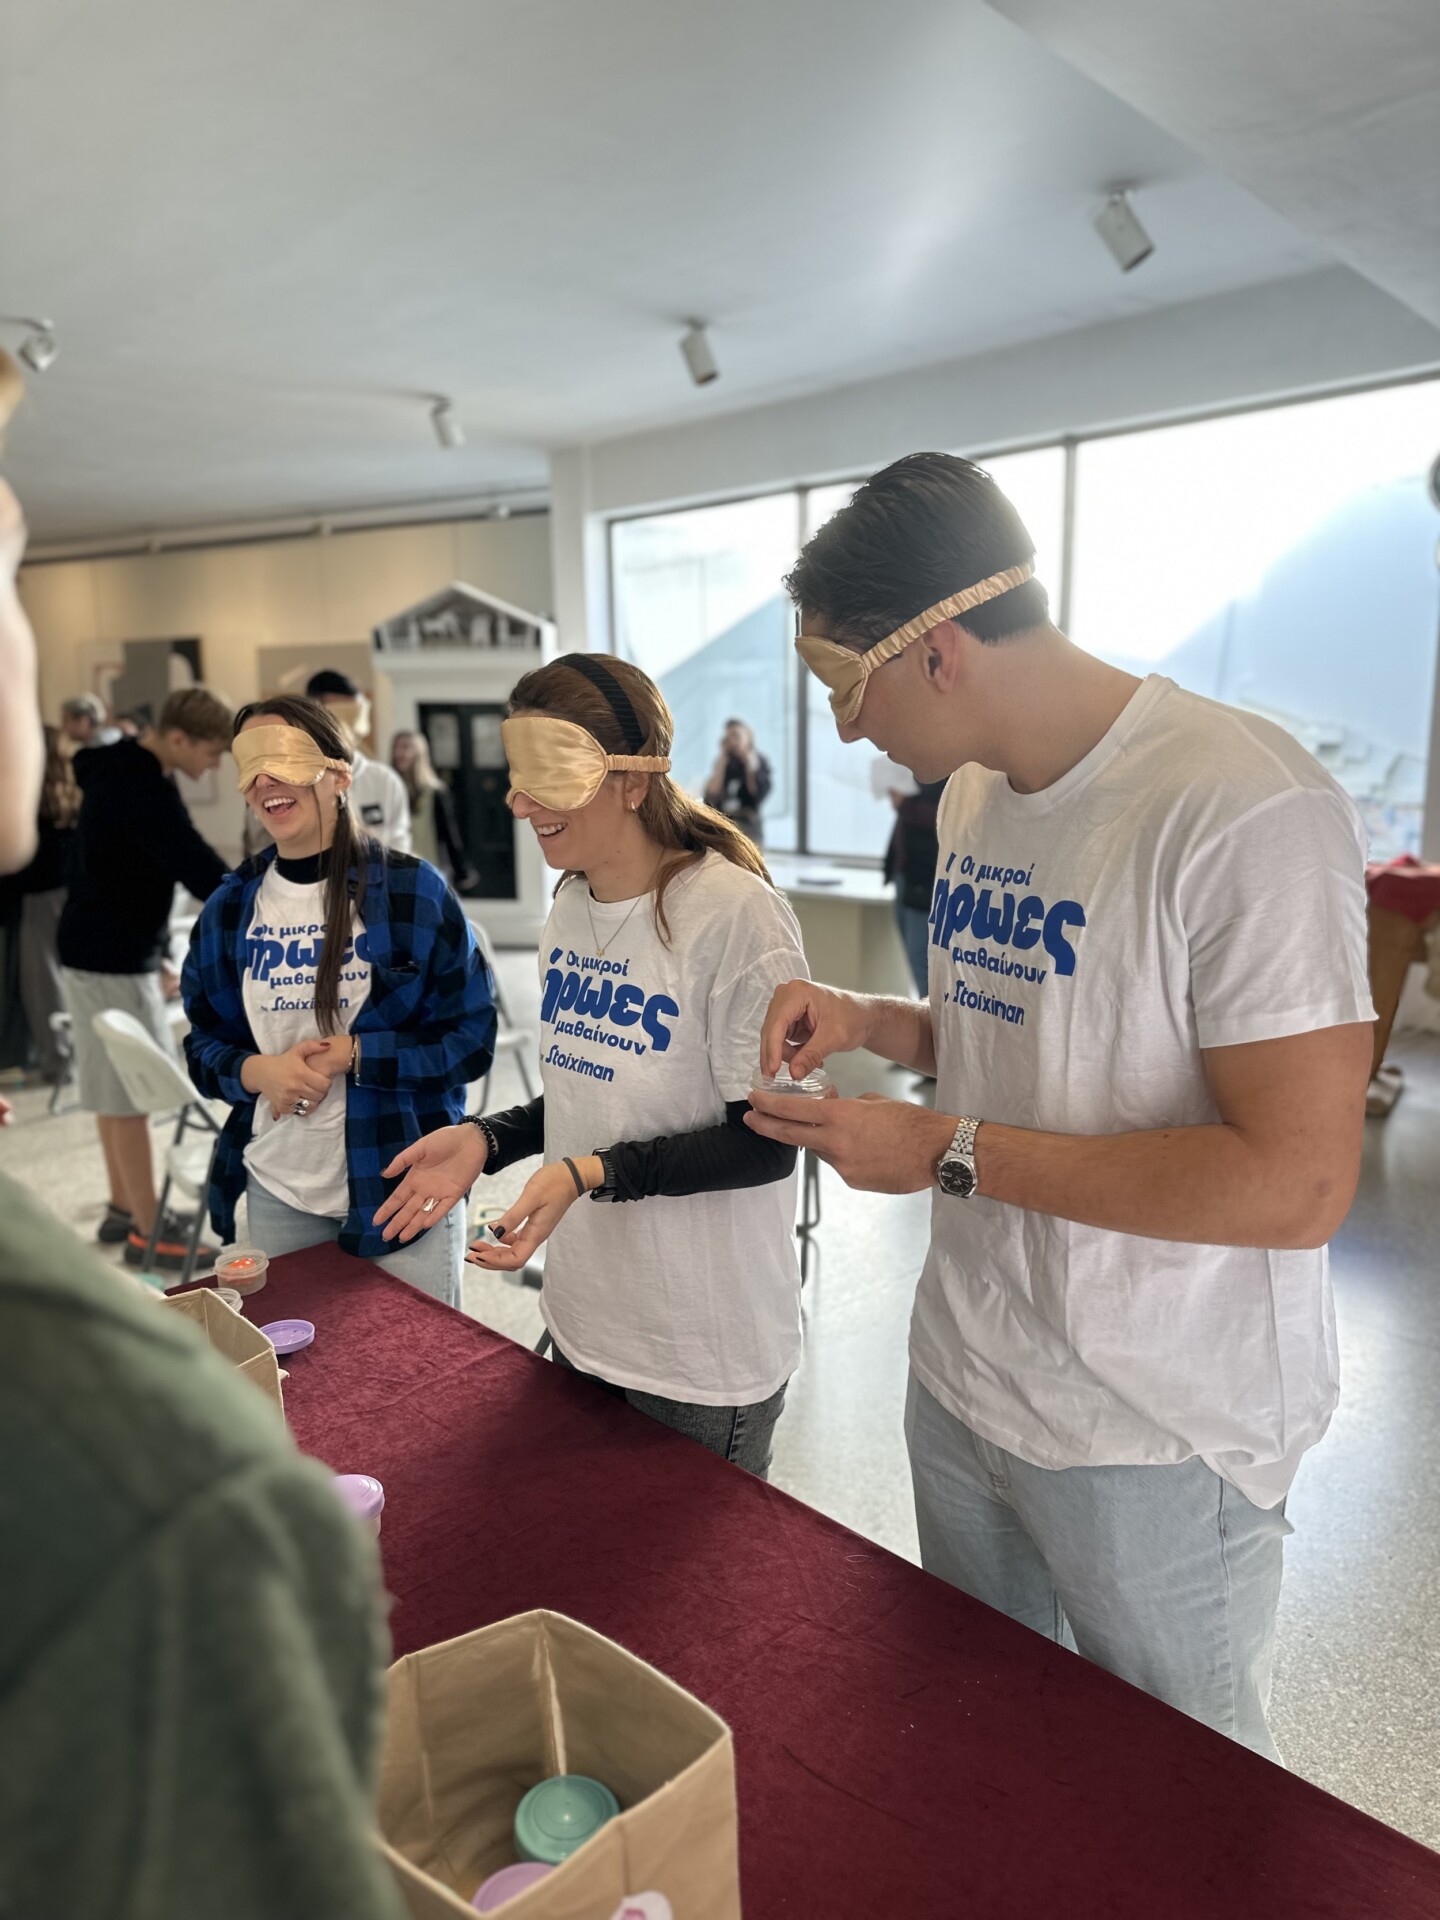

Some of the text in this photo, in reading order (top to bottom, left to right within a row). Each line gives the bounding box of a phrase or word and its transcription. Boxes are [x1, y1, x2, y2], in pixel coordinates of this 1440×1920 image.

[960, 855, 1035, 888] Οι μικροί
[566, 950, 630, 977] Οι μικροί
[952, 947, 1048, 985] μαθαίνουν
[952, 980, 1025, 1026] Stoiximan
[554, 1020, 647, 1056] μαθαίνουν
[545, 1044, 615, 1083] Stoiximan
